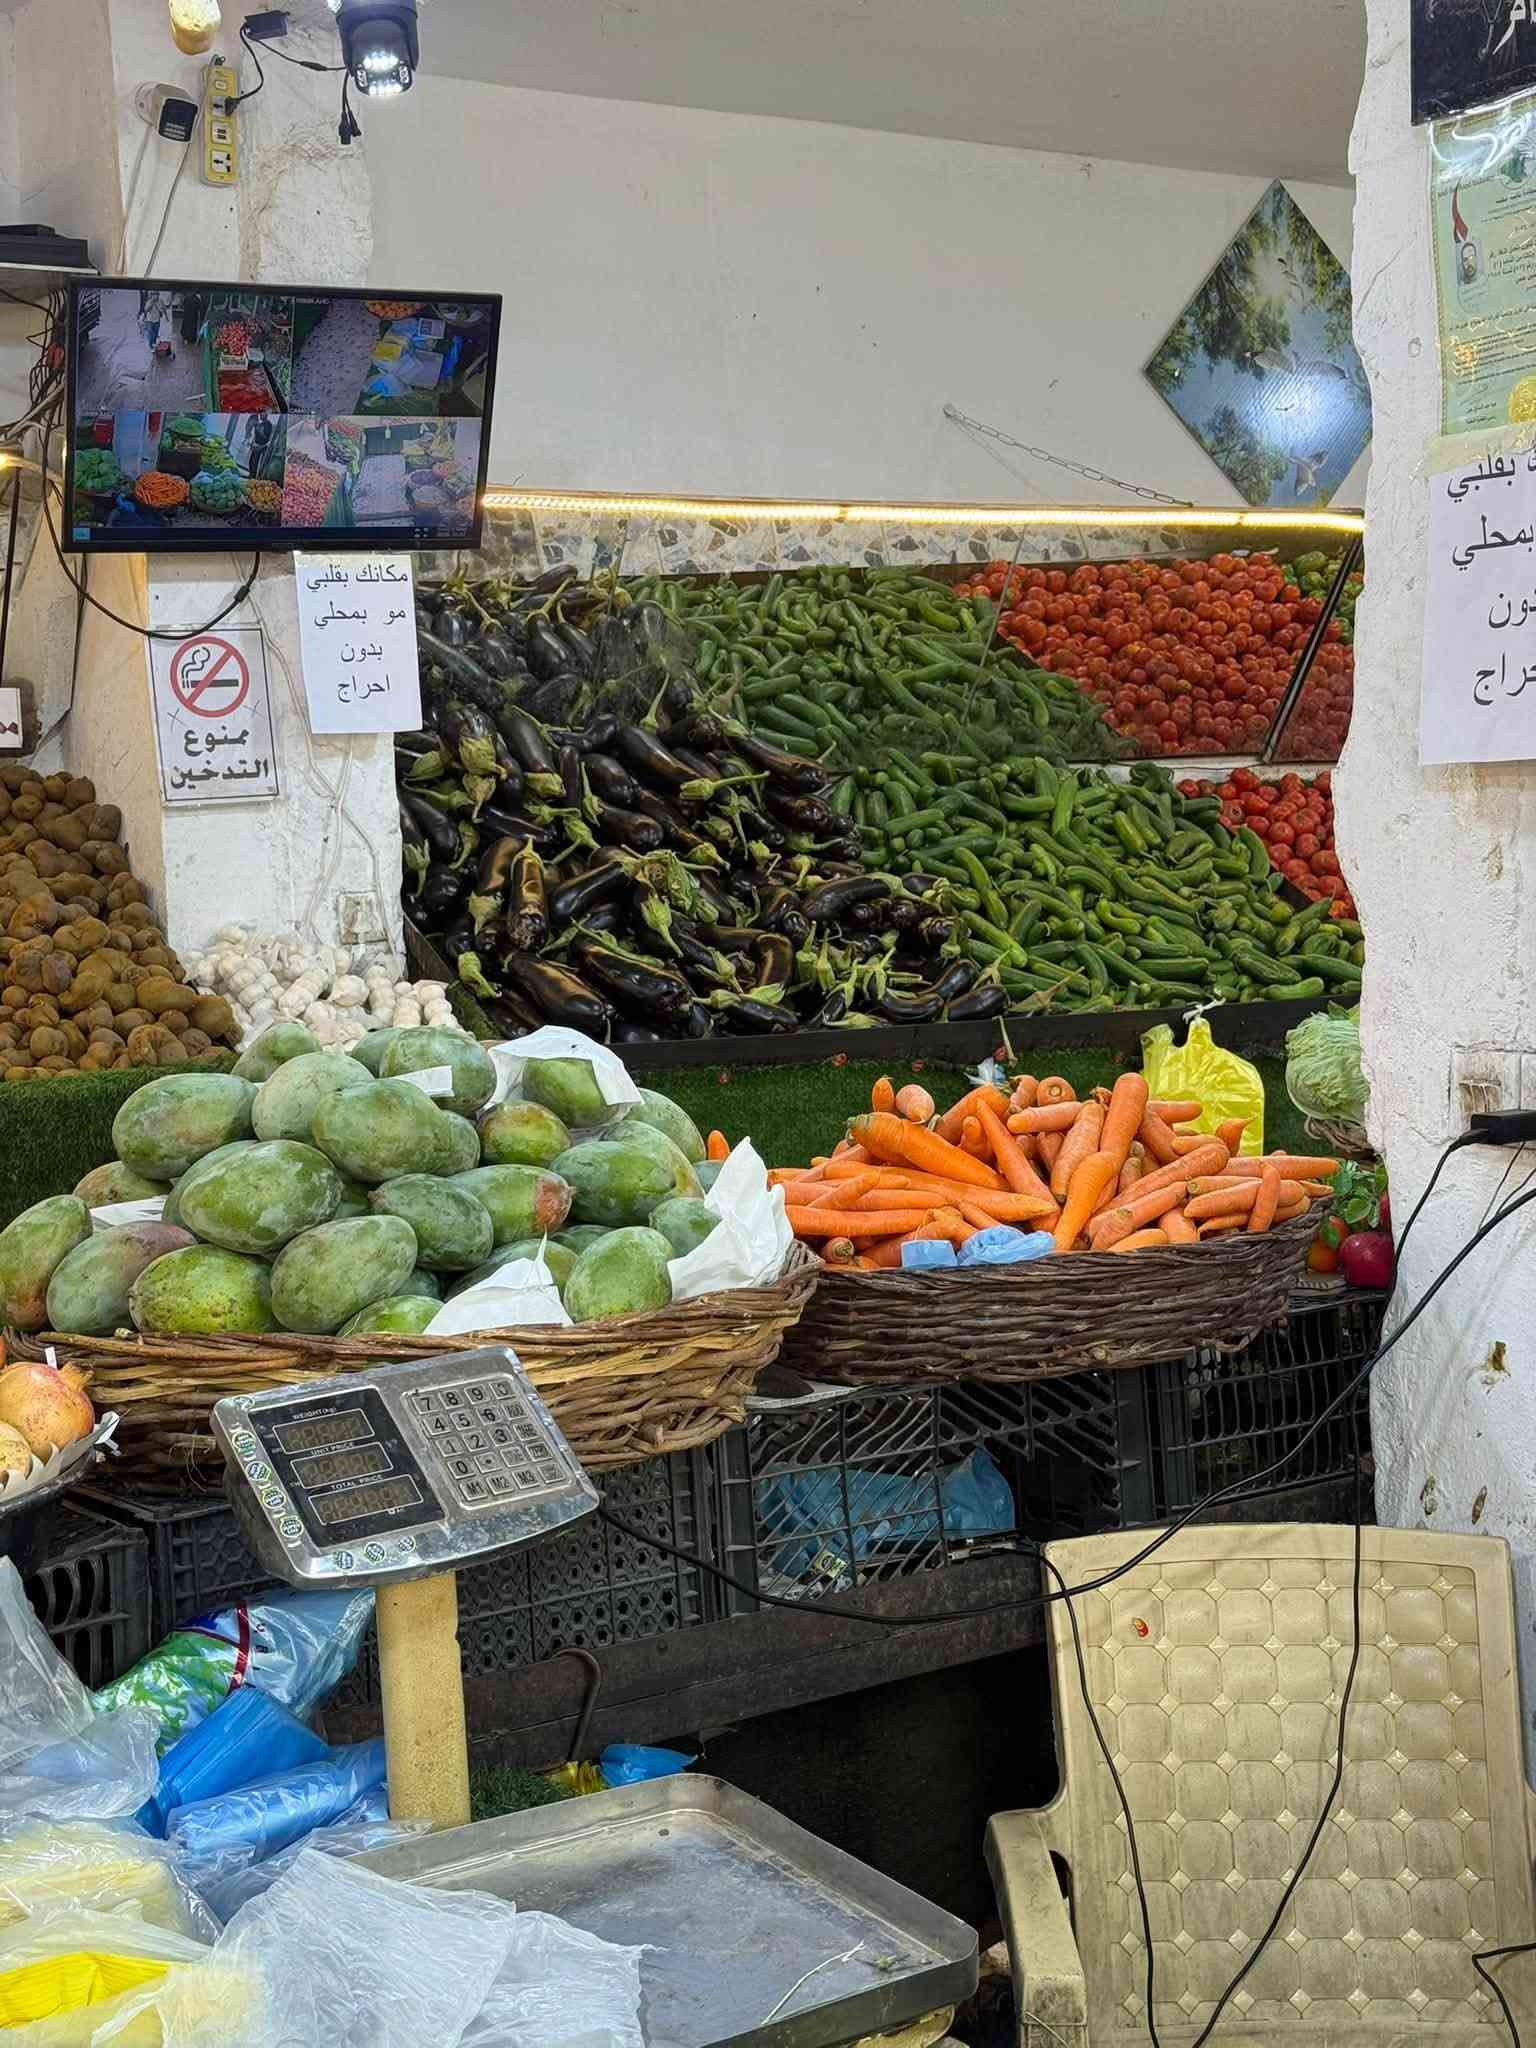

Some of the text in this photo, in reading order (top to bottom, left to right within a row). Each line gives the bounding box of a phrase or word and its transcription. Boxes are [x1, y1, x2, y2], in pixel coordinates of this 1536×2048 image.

[1447, 445, 1515, 503] بقلبي
[1453, 514, 1535, 571] بمحلي
[306, 563, 409, 592] مكانك بقلبي
[313, 600, 406, 630] مو بمحلي
[340, 643, 383, 662] بدون
[337, 674, 391, 703] احراج
[184, 725, 249, 757] ممنوع
[170, 758, 269, 789] التدخين
[446, 1392, 459, 1406] 8
[472, 1388, 484, 1401] 9
[434, 1417, 446, 1431] 4
[458, 1413, 471, 1427] 5
[484, 1408, 496, 1422] 6
[470, 1435, 484, 1449] 2
[495, 1429, 508, 1443] 3
[456, 1460, 468, 1475] 0
[331, 1481, 356, 1491] TOTAL
[466, 1479, 484, 1494] M1
[491, 1476, 509, 1489] M2
[517, 1471, 534, 1485] M3
